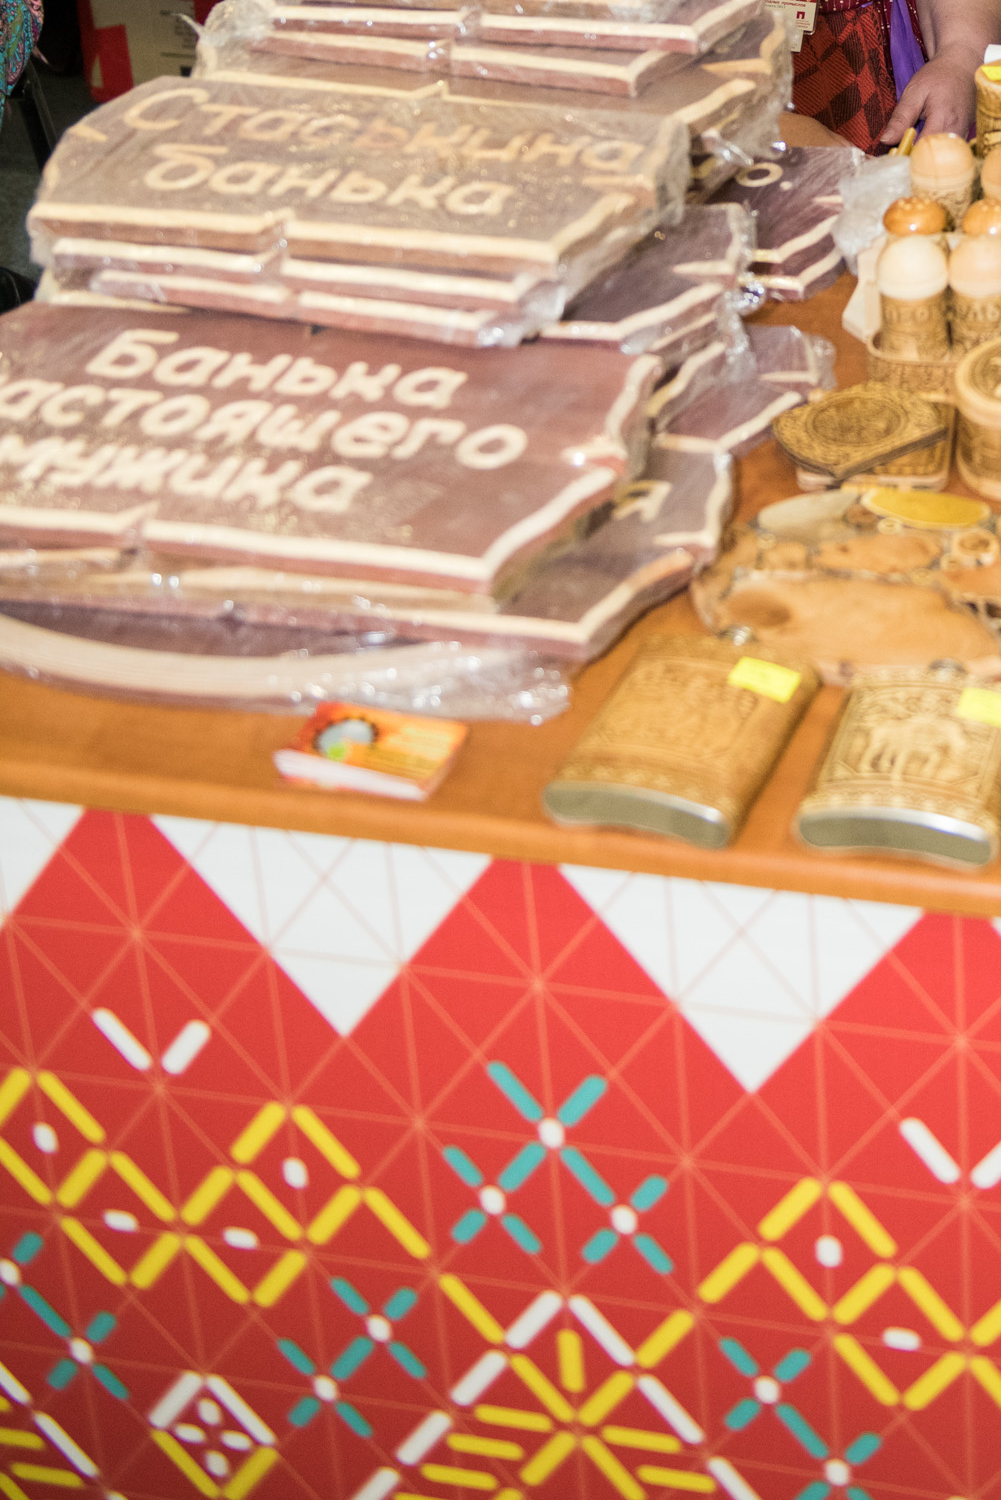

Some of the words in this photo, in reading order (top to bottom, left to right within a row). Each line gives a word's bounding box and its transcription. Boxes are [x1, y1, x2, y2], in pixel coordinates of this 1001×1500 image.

[122, 86, 645, 173] Стаськина
[143, 141, 516, 215] банька
[85, 328, 468, 409] Банька
